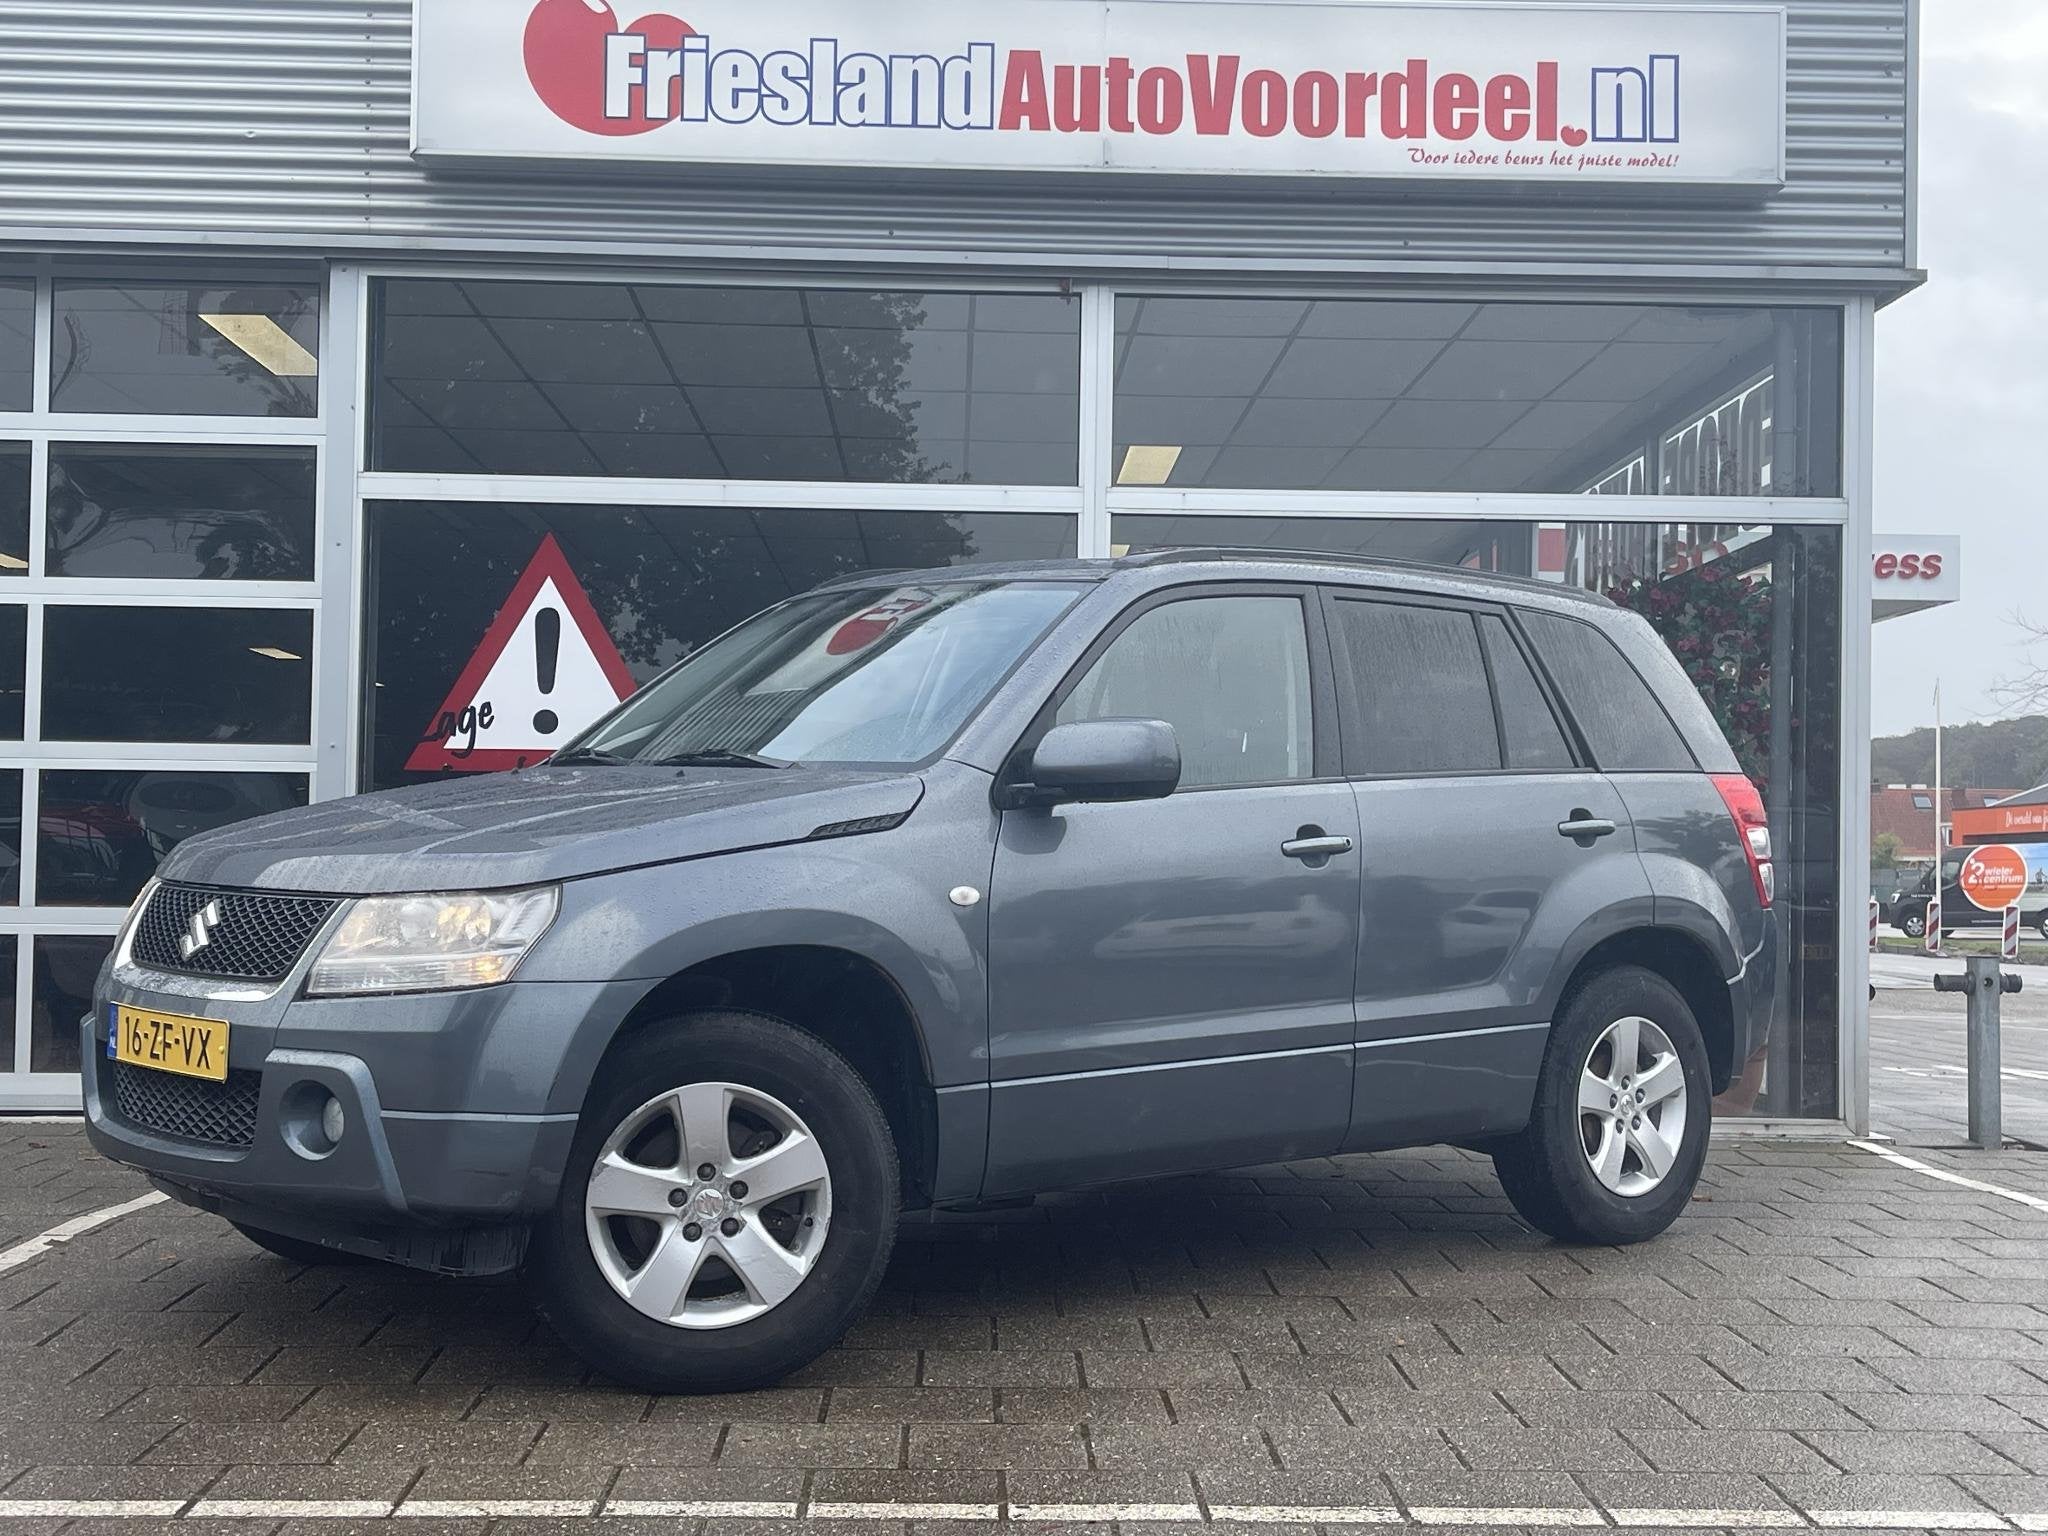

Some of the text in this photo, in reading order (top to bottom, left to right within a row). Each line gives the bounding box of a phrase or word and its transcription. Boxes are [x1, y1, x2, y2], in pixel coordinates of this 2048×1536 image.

[1407, 148, 1680, 171] Voor iedere beurs het juiste model!
[1872, 553, 1943, 580] ess
[125, 1015, 212, 1070] 16-ZF-VX
